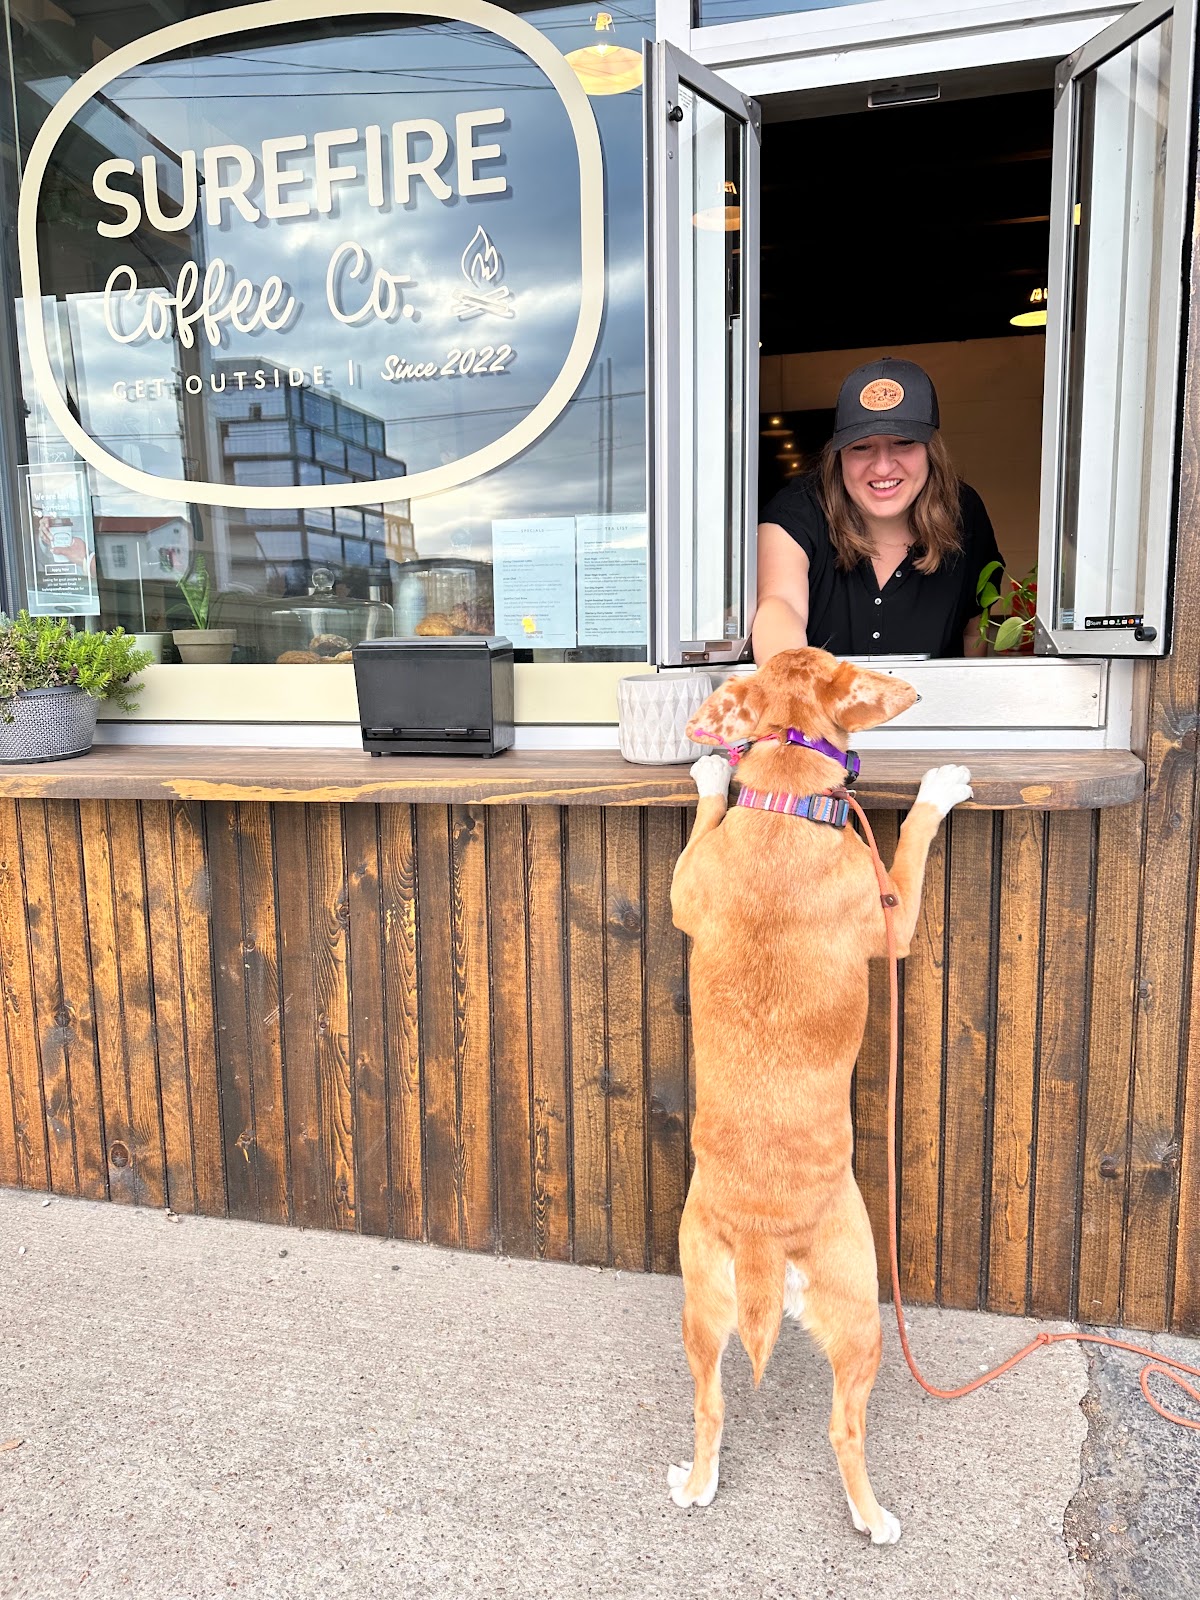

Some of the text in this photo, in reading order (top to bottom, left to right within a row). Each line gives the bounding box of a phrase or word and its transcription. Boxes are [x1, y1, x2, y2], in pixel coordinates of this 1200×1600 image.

[92, 107, 508, 238] SUREFIRE
[103, 241, 416, 349] Coffee Co.
[112, 343, 512, 400] GET OUTSIDE Since 2022
